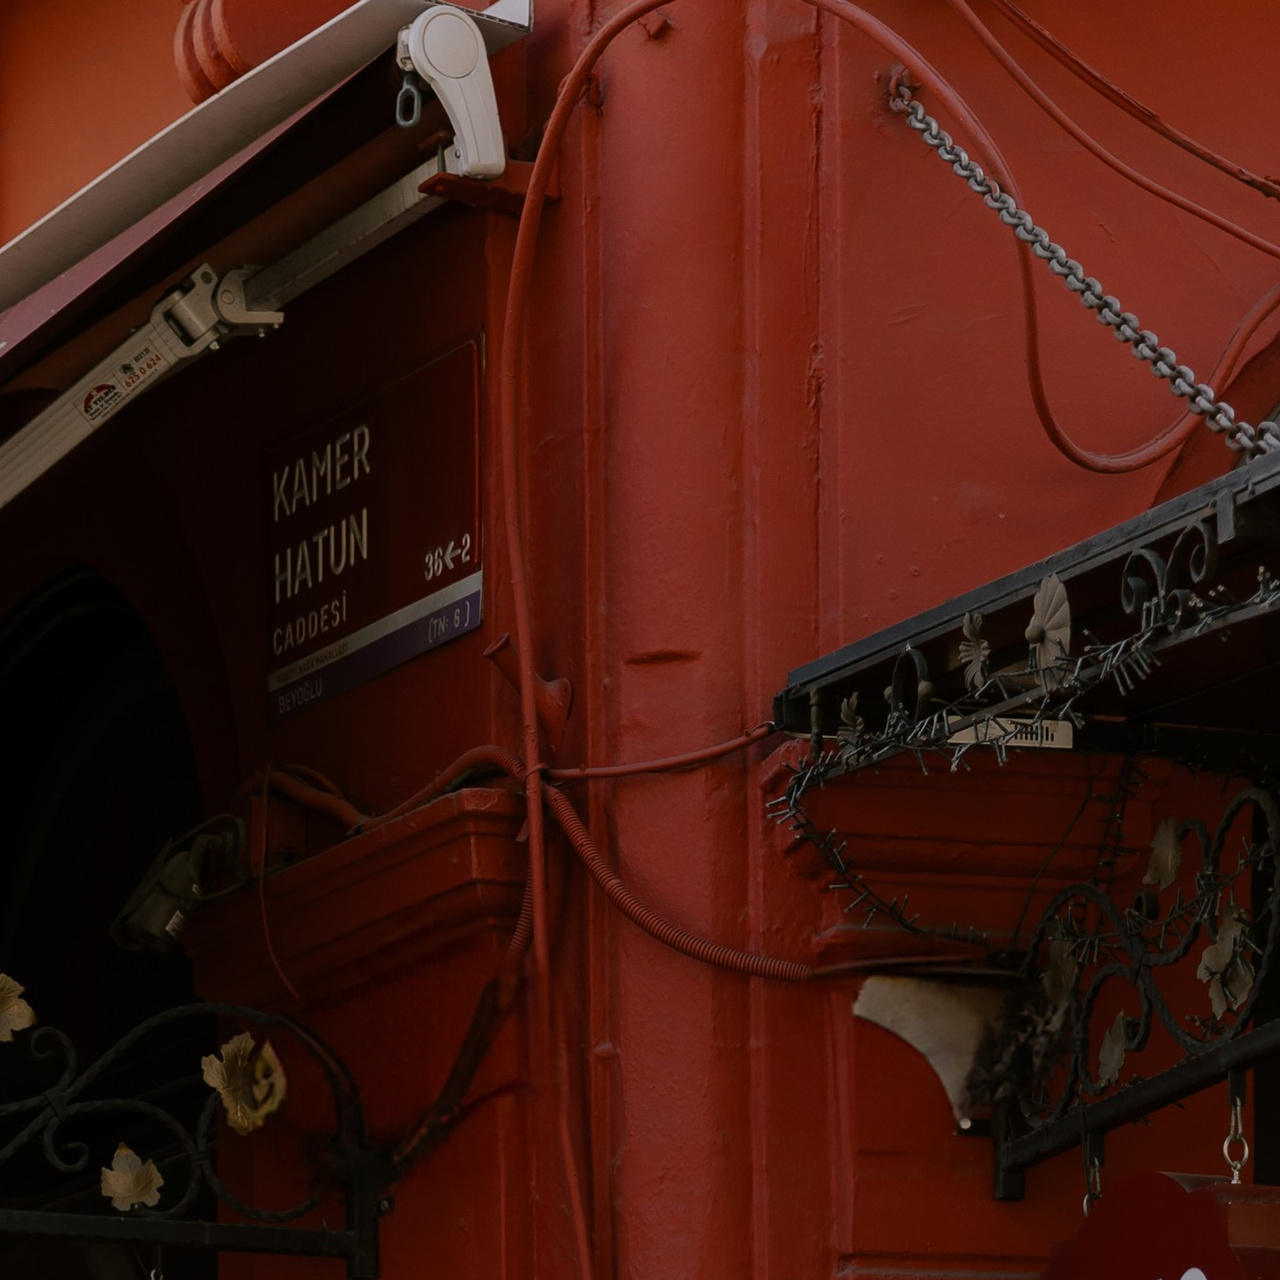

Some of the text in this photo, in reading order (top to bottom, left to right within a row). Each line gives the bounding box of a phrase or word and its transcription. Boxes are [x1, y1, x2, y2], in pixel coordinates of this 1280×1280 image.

[273, 423, 371, 522] KAMER
[275, 508, 368, 604] HATUN
[273, 589, 347, 656] CADDESİ
[278, 677, 323, 714] BEYOĞLU
